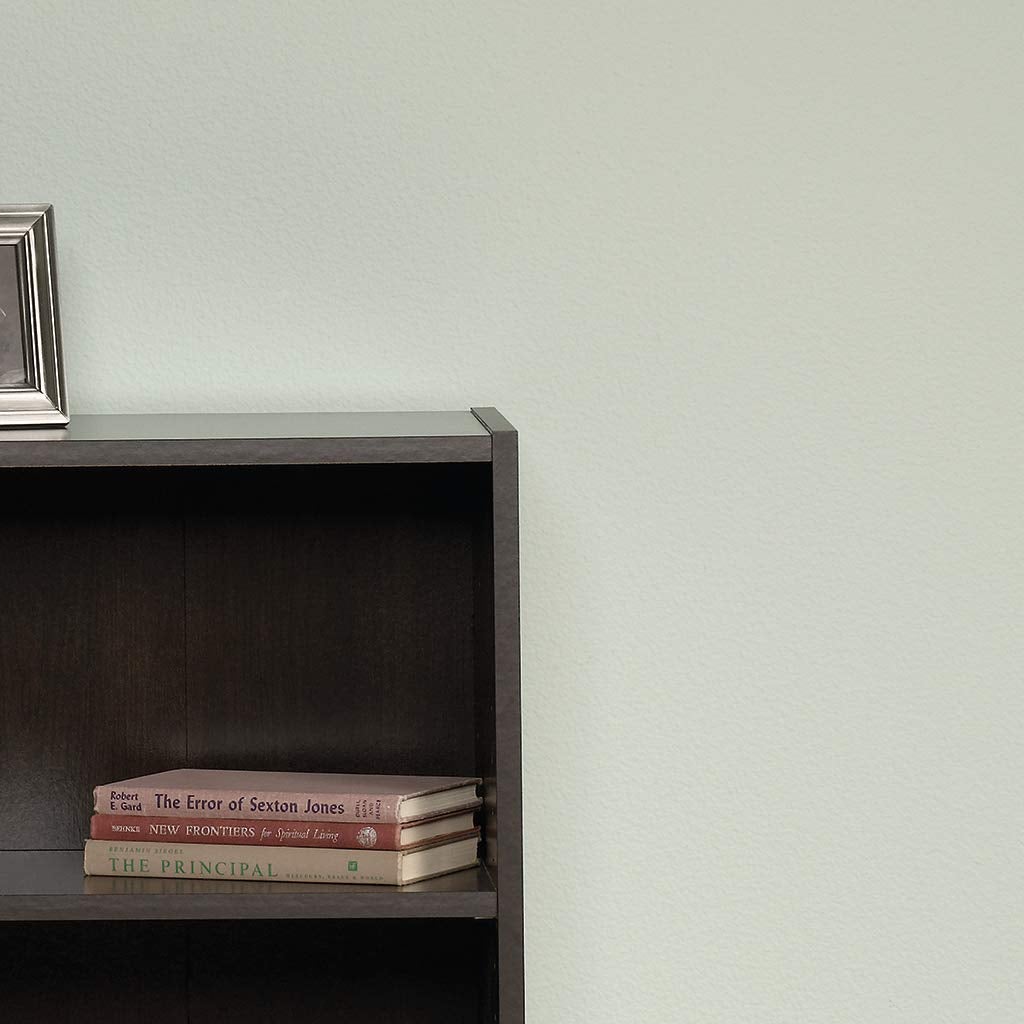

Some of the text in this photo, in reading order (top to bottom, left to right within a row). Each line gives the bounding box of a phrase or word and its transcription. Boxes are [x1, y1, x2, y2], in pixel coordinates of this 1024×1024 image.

[110, 791, 138, 801] Robert
[155, 794, 345, 814] The Error of Sexton Jones
[120, 802, 142, 811] Gard
[149, 824, 180, 835] NEW
[186, 825, 256, 837] FRONTIERS
[259, 827, 272, 841] for
[275, 827, 310, 841] Spiritual
[313, 827, 339, 843] Living
[109, 857, 150, 872] THE
[161, 859, 278, 877] PRINCIPAL
